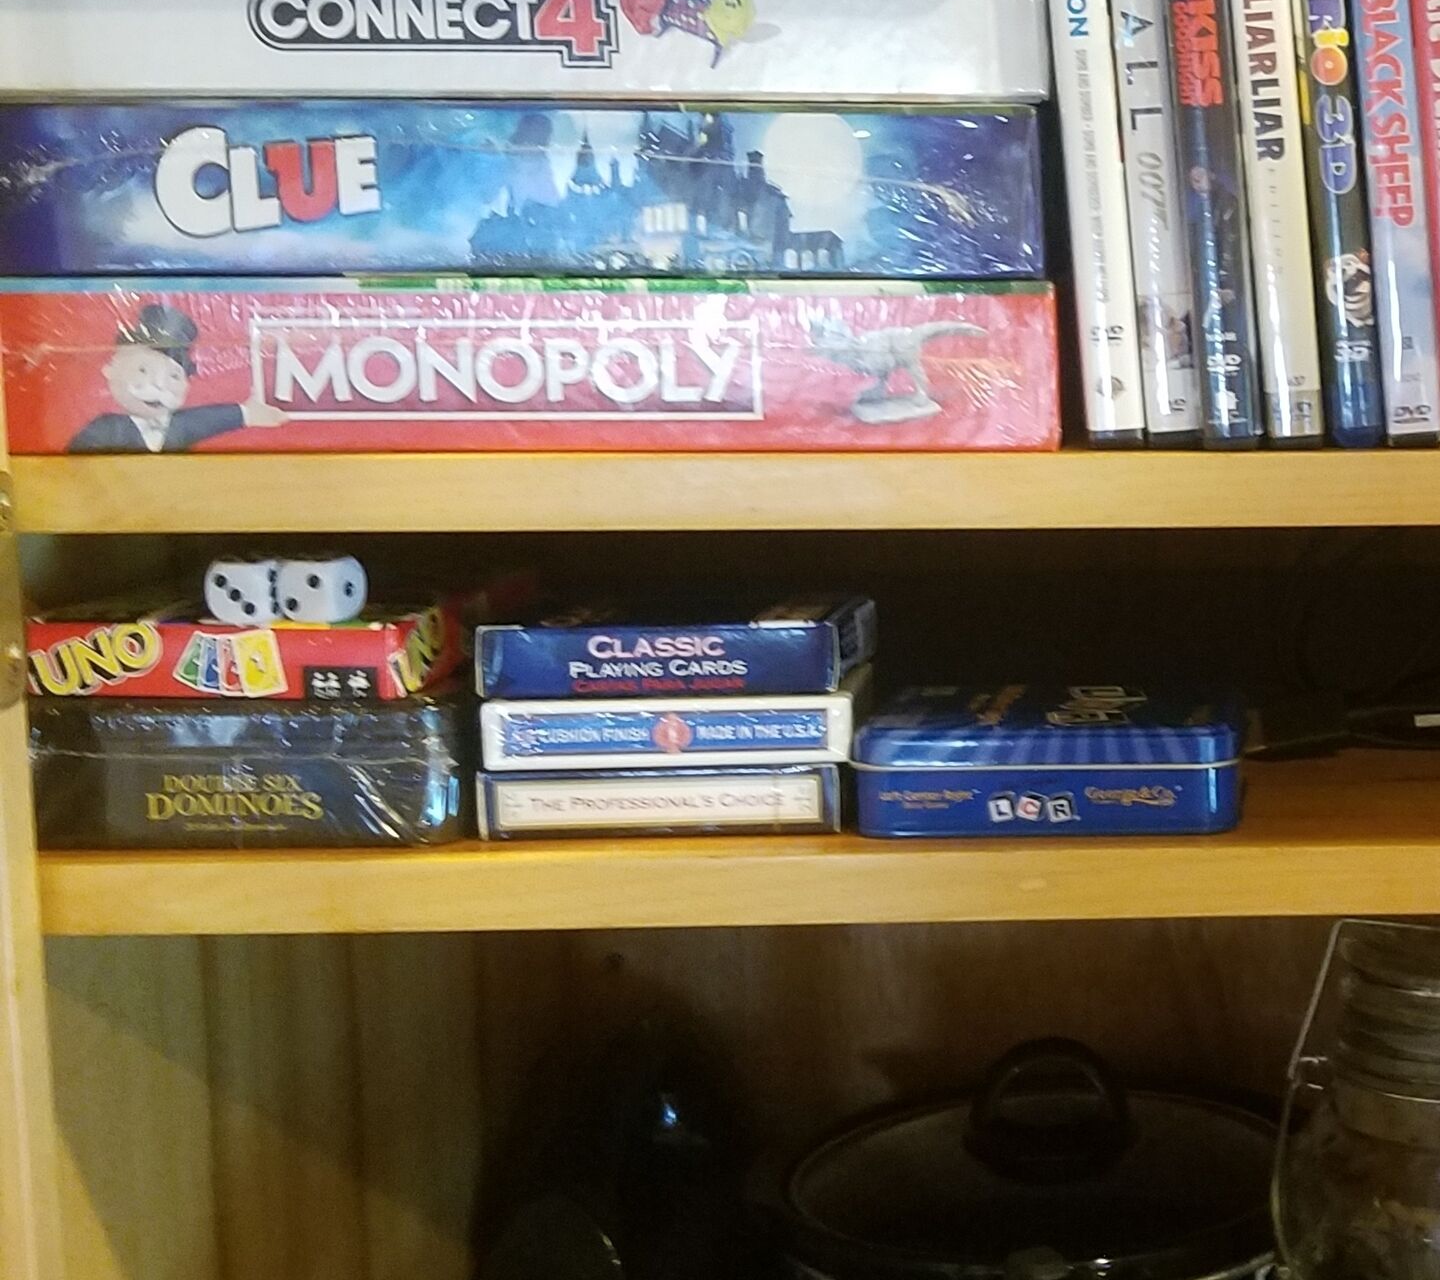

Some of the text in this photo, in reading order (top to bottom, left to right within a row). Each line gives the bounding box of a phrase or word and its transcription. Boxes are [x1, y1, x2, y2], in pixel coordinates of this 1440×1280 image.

[1189, 0, 1224, 106] KISS
[1315, 93, 1357, 194] 3D
[154, 123, 385, 239] CLUE
[1366, 110, 1415, 227] SHEEP
[273, 336, 744, 408] MONOPOLY
[31, 622, 160, 697] UNO
[586, 635, 726, 659] CLASSIC
[568, 658, 749, 679] PLAYING CARDS
[601, 727, 649, 742] FINISH
[696, 725, 734, 740] MADE
[735, 725, 752, 739] IN
[754, 724, 783, 739] THE
[163, 773, 305, 793] DOUBLE SIX
[145, 791, 324, 821] DOMINOES
[530, 792, 786, 812] THE PROFESSIONAL'S CHOICE
